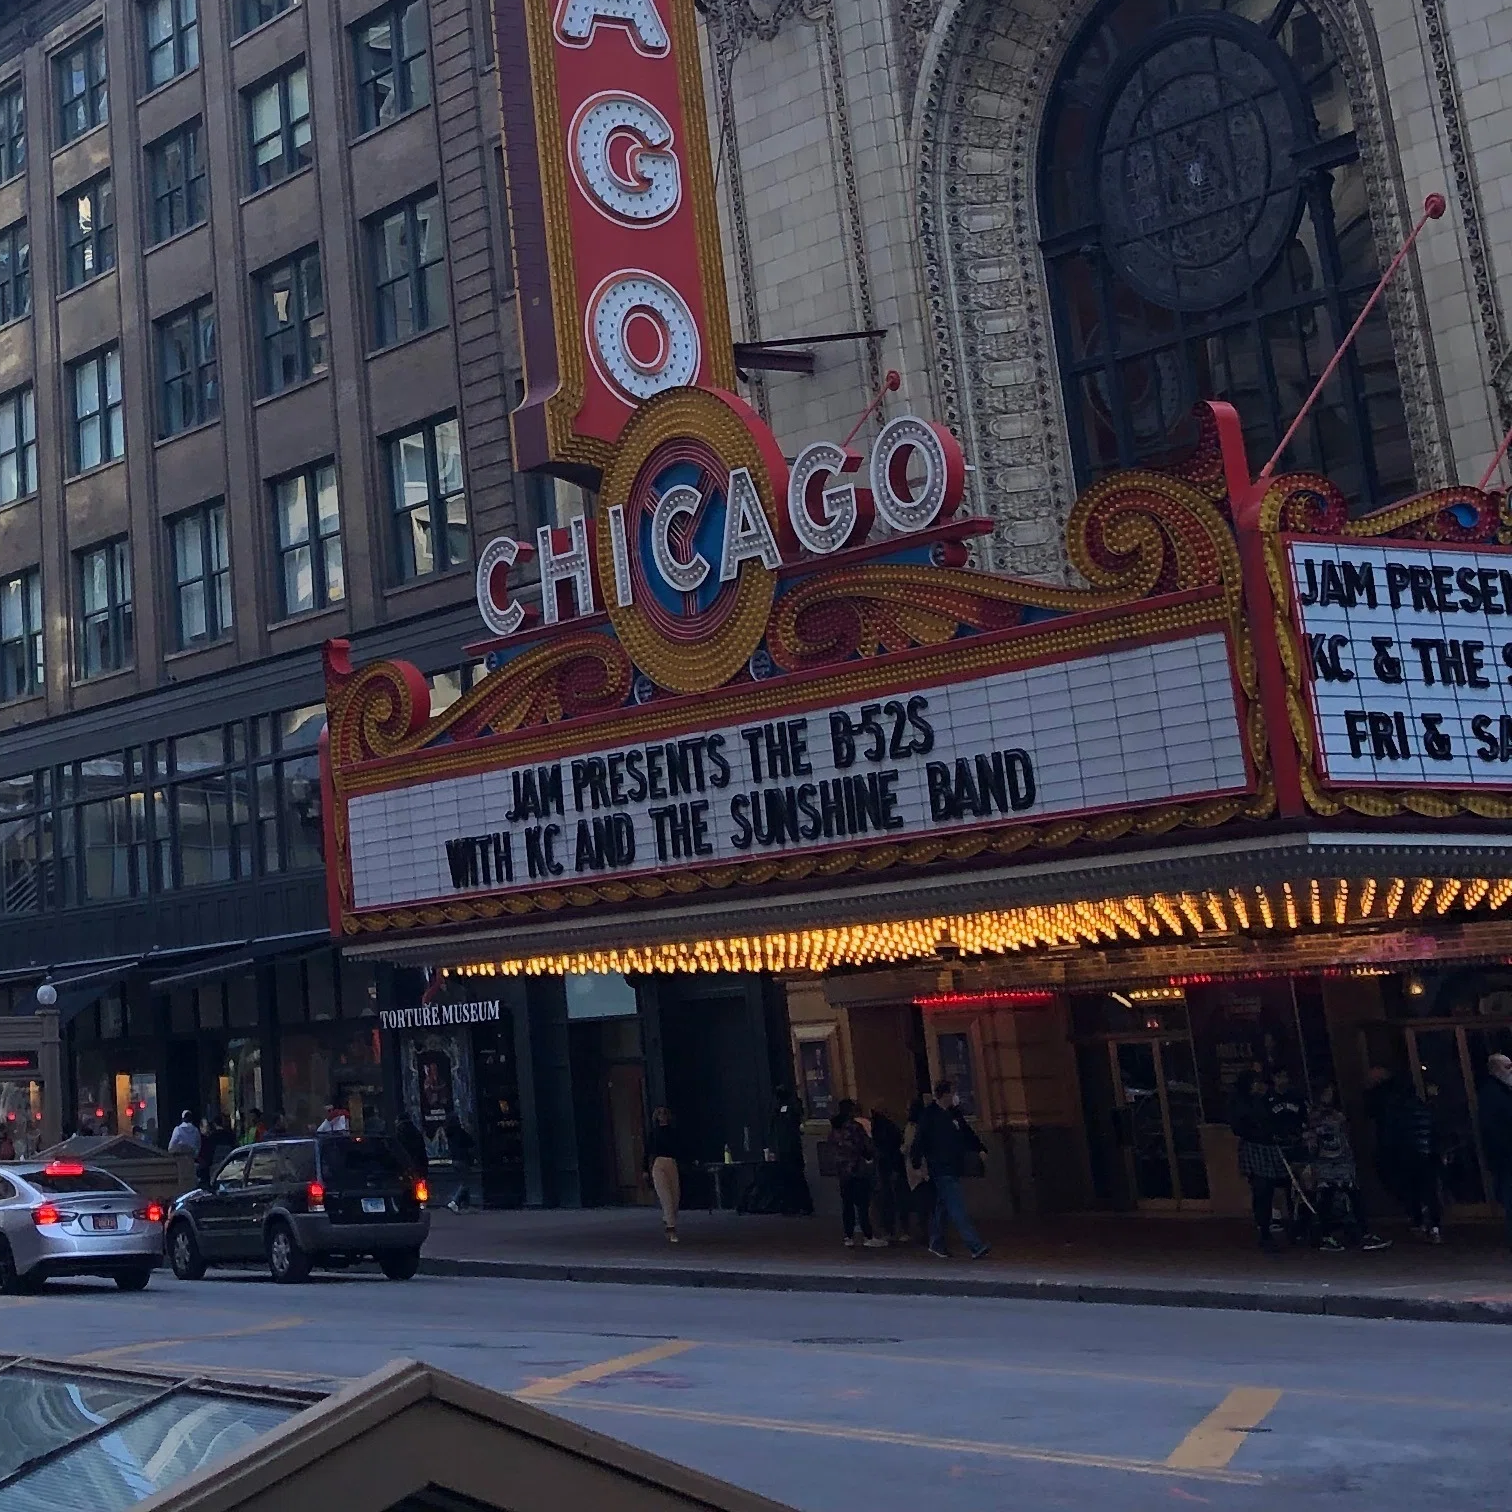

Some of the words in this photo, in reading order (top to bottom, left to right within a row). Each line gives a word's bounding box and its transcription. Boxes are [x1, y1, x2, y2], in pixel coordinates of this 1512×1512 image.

[476, 415, 950, 636] CHICAGO
[1301, 558, 1378, 610] JAM
[1306, 633, 1355, 683] KC
[1371, 636, 1403, 684] &
[1411, 637, 1491, 689] THE
[505, 763, 565, 822] JAM
[571, 733, 731, 812] PRESENTS
[740, 712, 814, 785] THE
[828, 695, 935, 770] B-52S
[1344, 709, 1412, 761] FRI
[1421, 712, 1454, 761] &
[445, 831, 514, 889] WITH
[525, 823, 564, 879] KC
[575, 811, 637, 873] AND
[648, 798, 714, 861] THE
[730, 768, 905, 850] SUNSHINE
[926, 746, 1038, 823] BAND
[380, 1006, 440, 1029] TORTURE
[442, 1000, 500, 1025] MUSEUM
